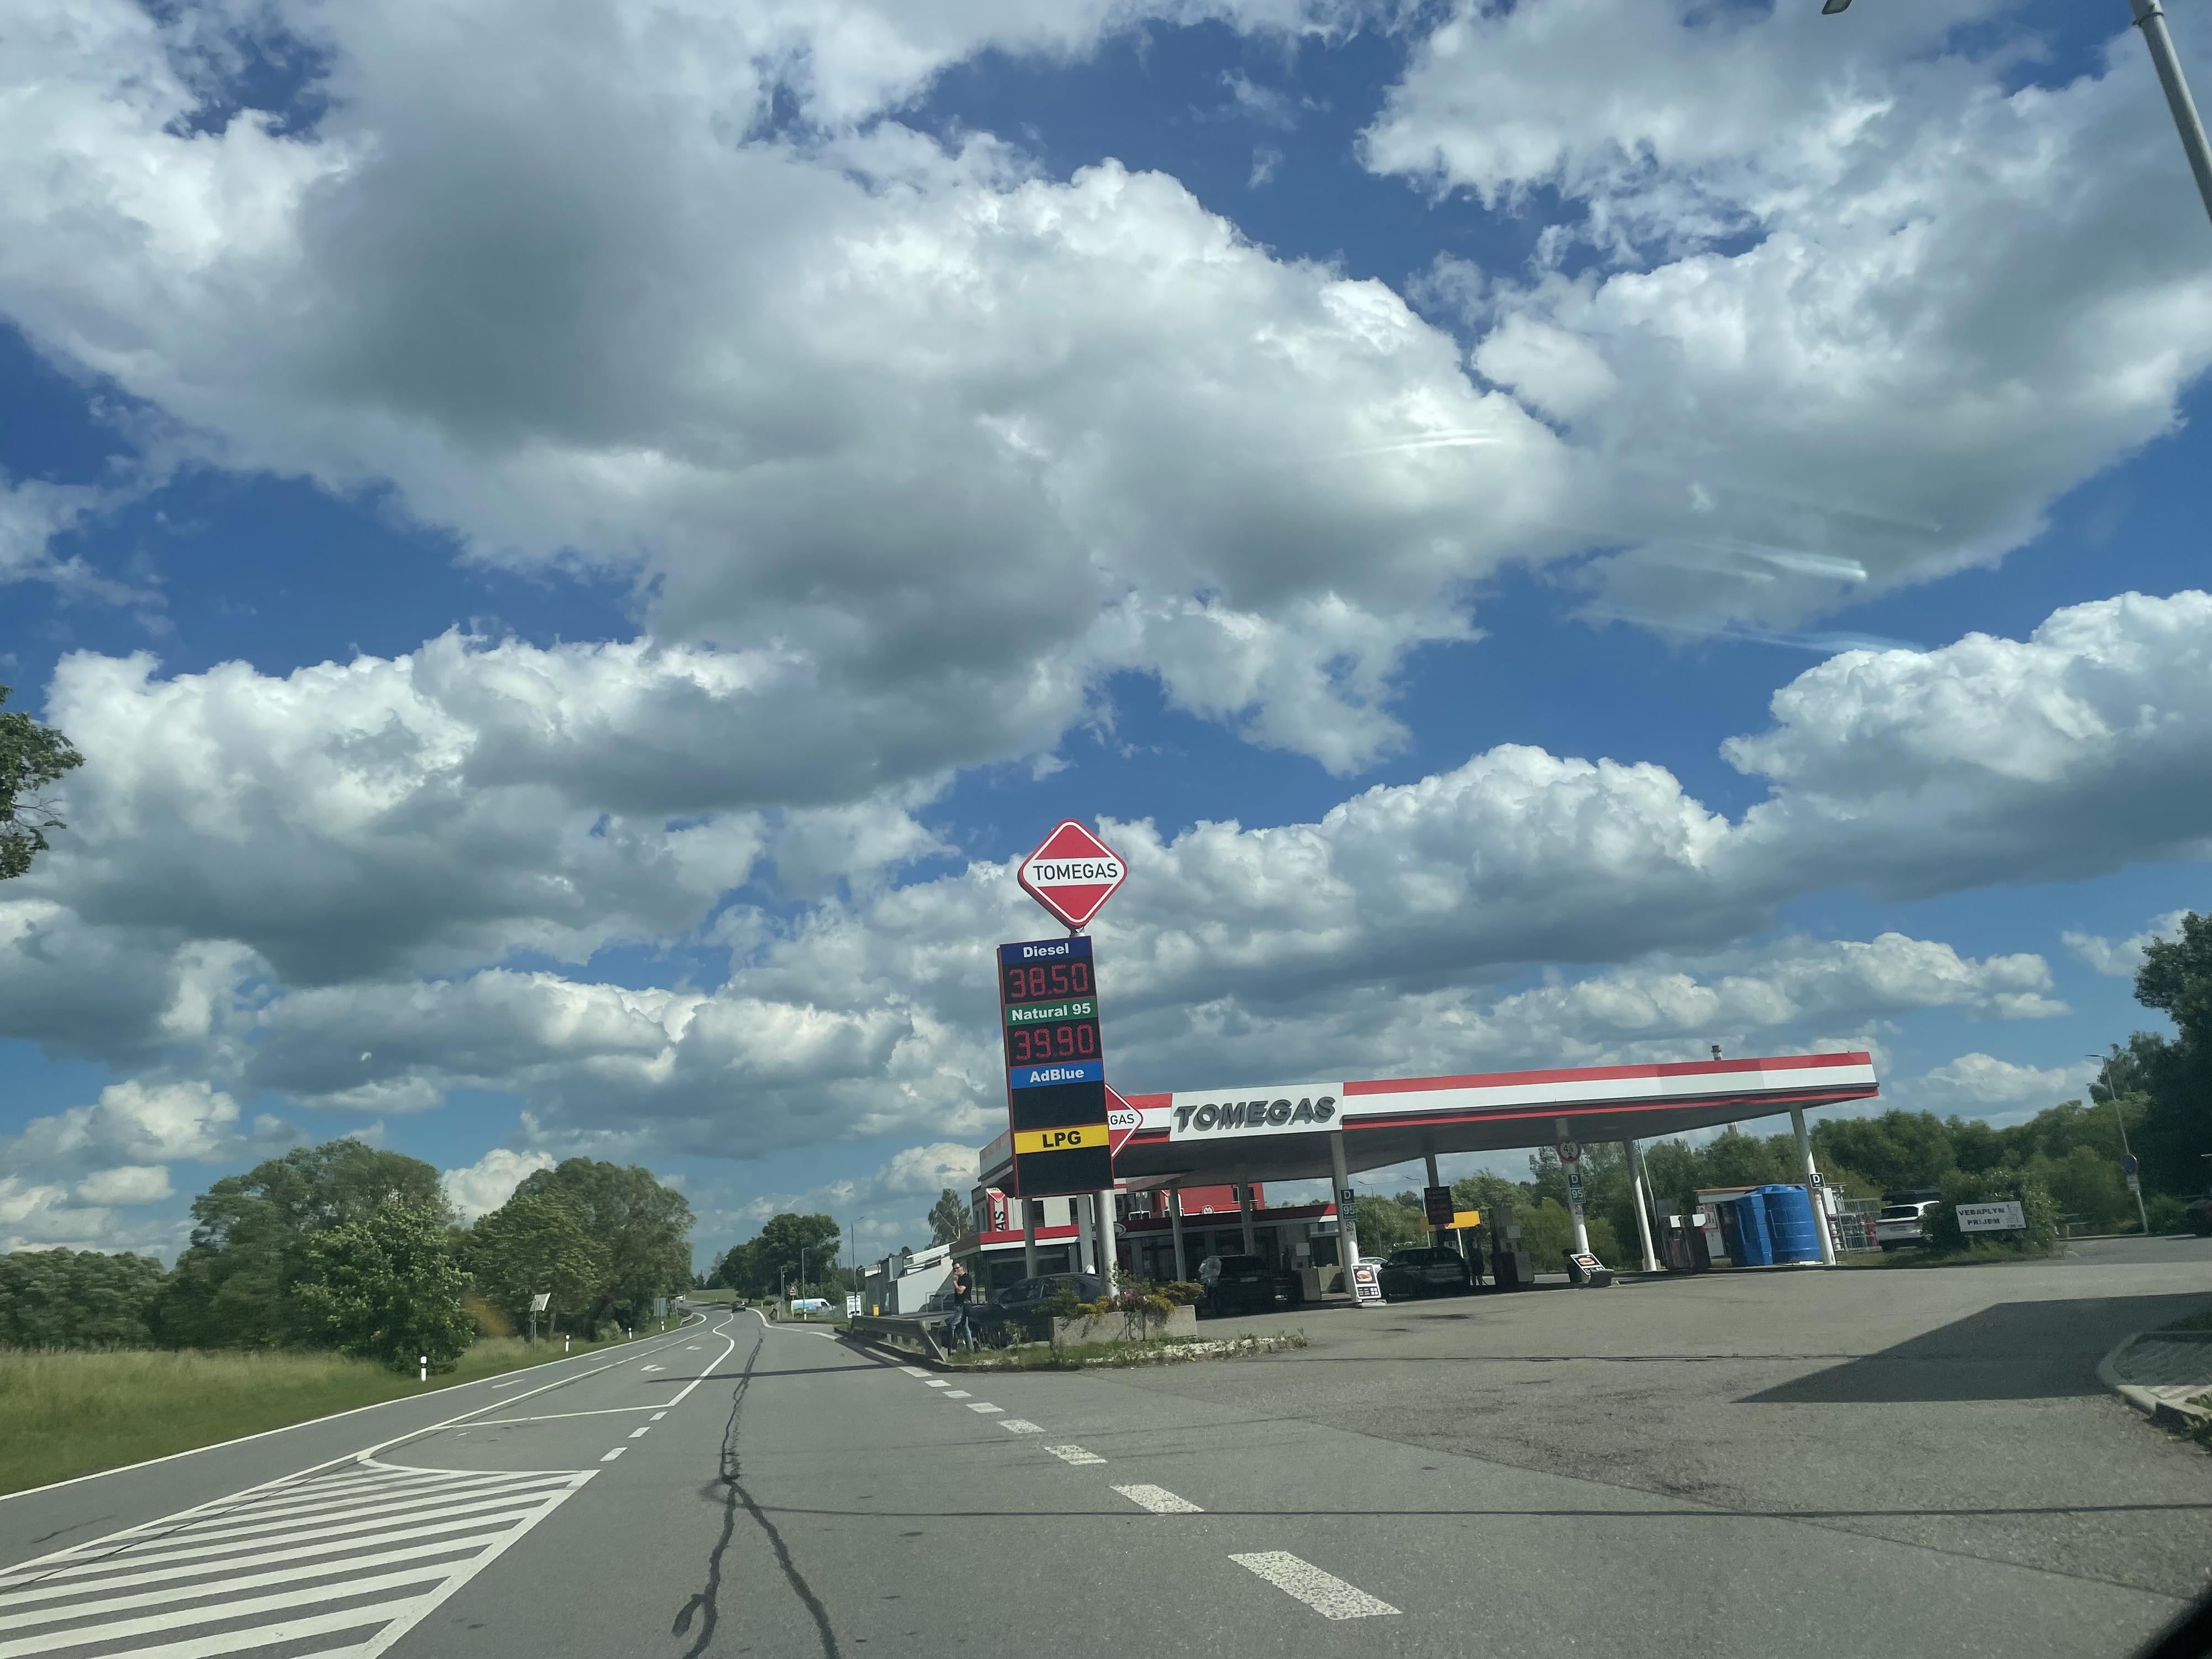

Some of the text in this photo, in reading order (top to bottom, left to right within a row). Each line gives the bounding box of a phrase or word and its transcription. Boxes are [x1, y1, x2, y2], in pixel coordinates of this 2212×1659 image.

[1033, 863, 1118, 880] TOMEGAS
[1023, 943, 1069, 958] Diesel
[1009, 962, 1088, 998] 38.50
[1012, 1003, 1091, 1021] Natural 95
[1030, 1068, 1084, 1083] AdBlue
[1108, 1114, 1134, 1125] GAS
[1173, 1097, 1336, 1133] TOMEGAS
[1042, 1131, 1081, 1147] LPG
[1571, 1175, 1578, 1183] D
[1813, 1175, 1820, 1183] D
[1344, 1191, 1351, 1199] D
[1572, 1190, 1583, 1198] 95
[1343, 1206, 1355, 1214] 95
